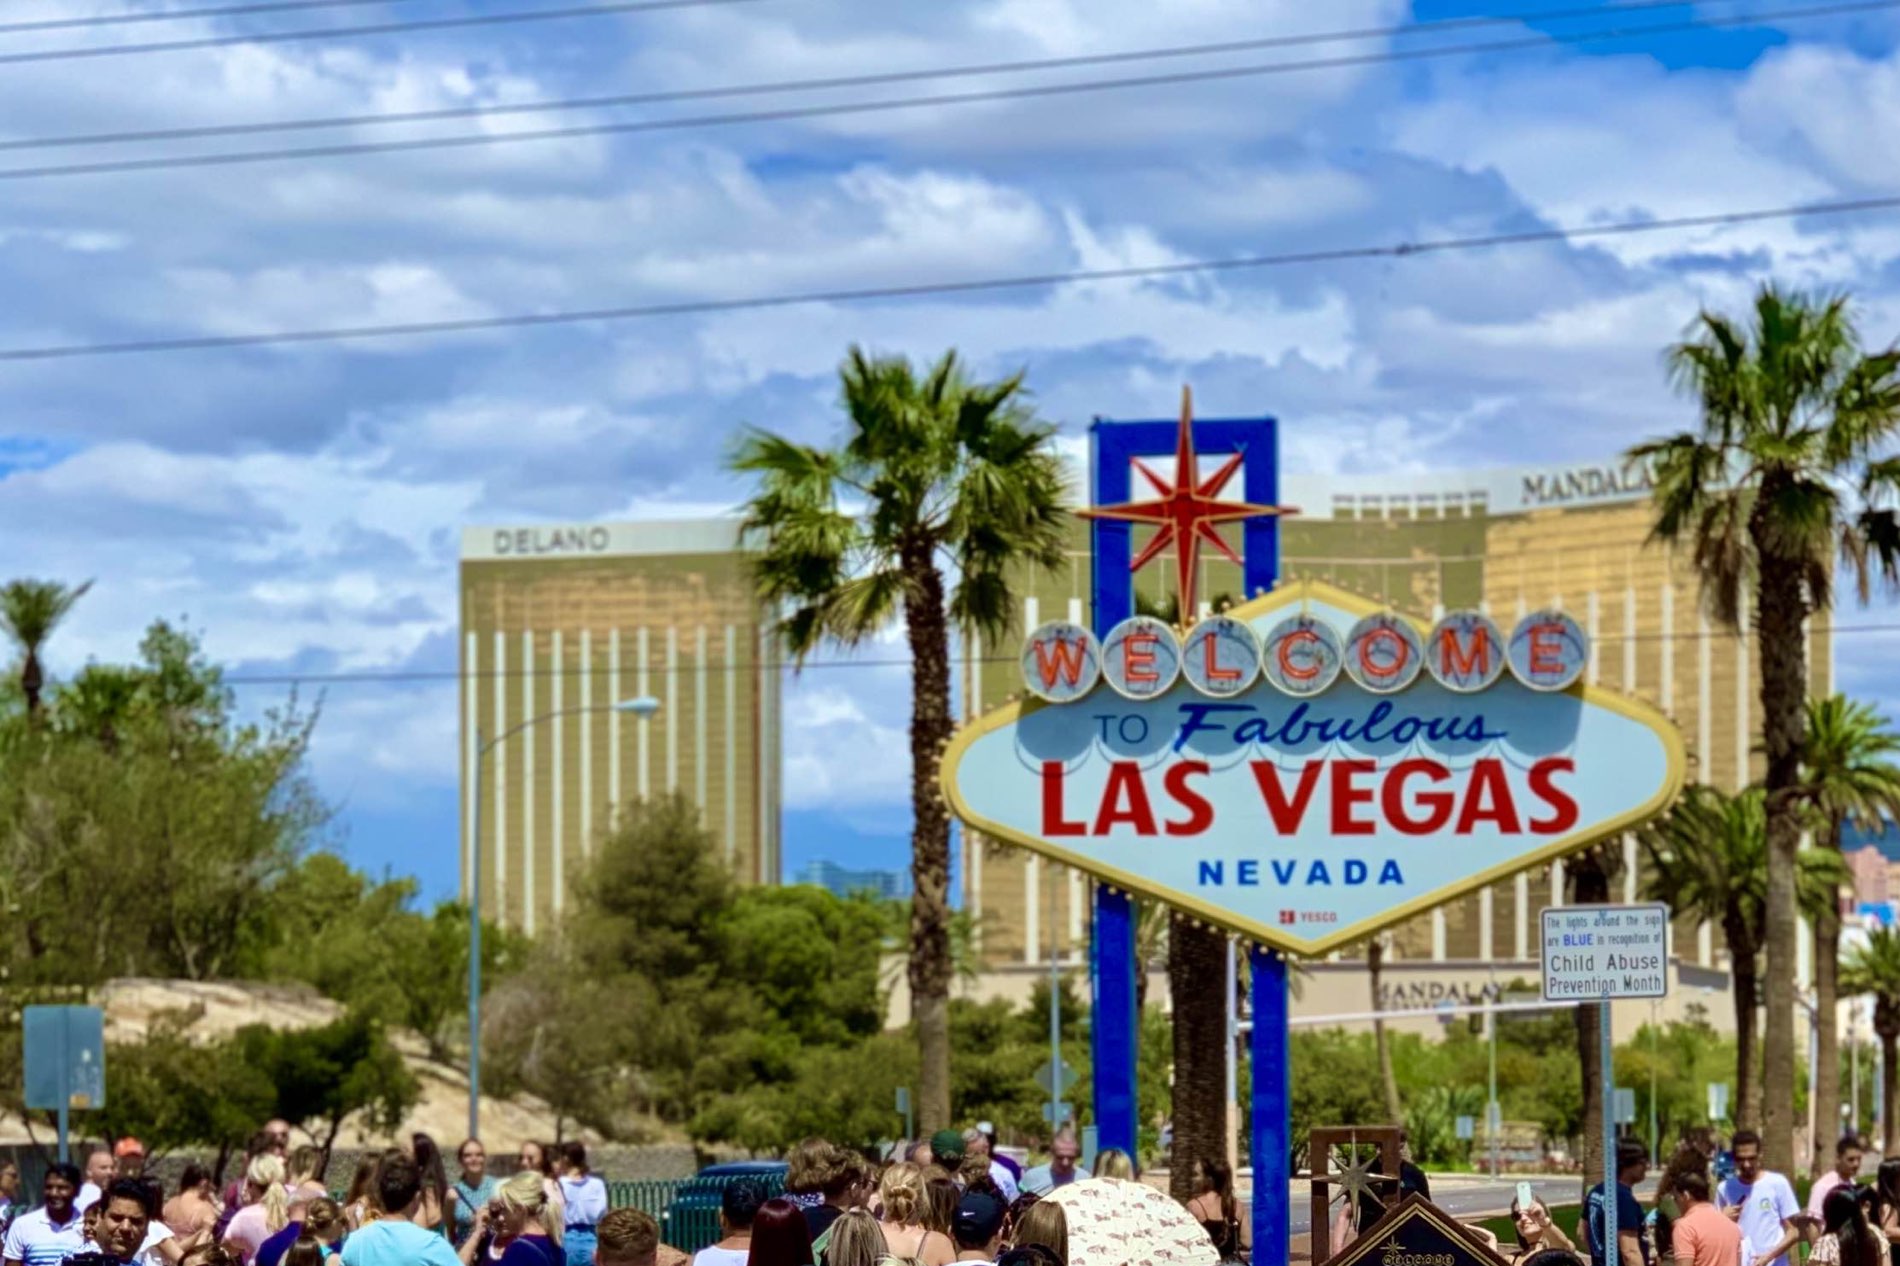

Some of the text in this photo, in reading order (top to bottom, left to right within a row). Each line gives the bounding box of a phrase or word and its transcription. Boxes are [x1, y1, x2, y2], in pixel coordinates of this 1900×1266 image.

[1521, 457, 1657, 504] MANDALA
[494, 526, 610, 554] DELANO
[1034, 622, 1566, 689] WELCOME
[1093, 701, 1508, 753] TO Fabulous
[1041, 757, 1580, 837] LAS VEGAS
[1199, 858, 1405, 887] NEVADA
[1301, 911, 1338, 923] YESCO
[1547, 914, 1661, 931] The lights around the sign
[1547, 932, 1661, 948] are BLUE in recognition of
[1551, 953, 1659, 972] Child Abuse
[1380, 981, 1504, 1000] ANDALA
[1550, 974, 1661, 994] Prevention Month
[1383, 1255, 1454, 1266] WELCOME
